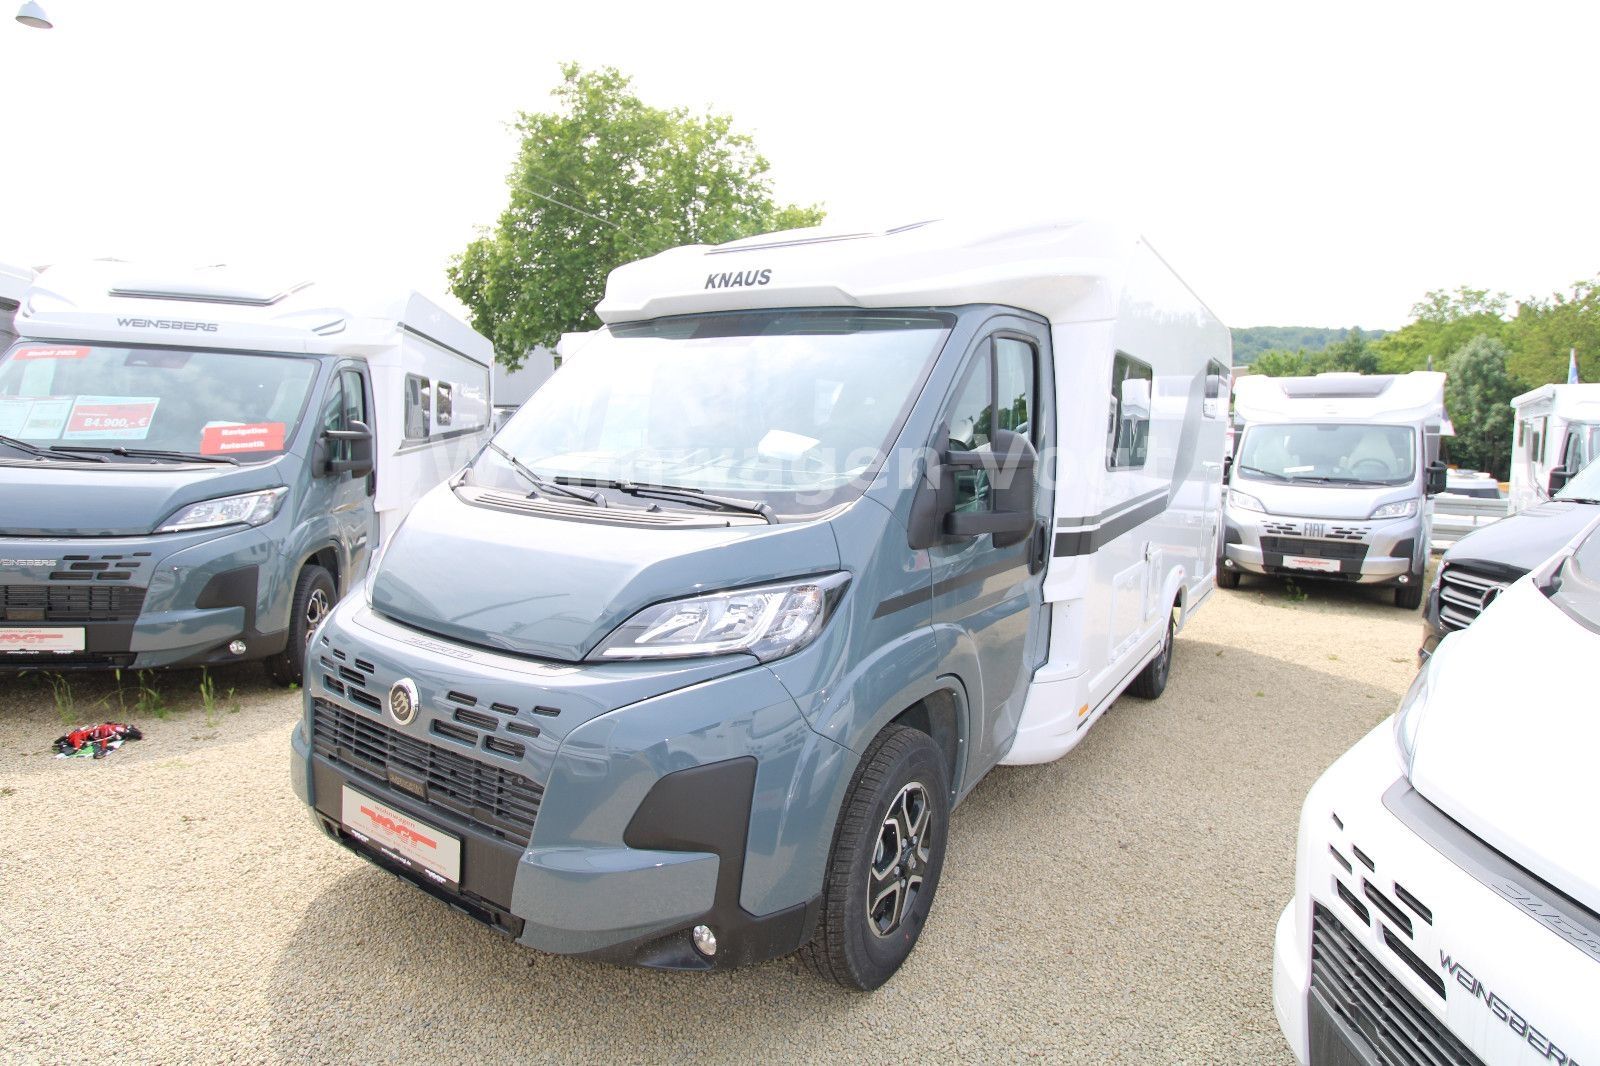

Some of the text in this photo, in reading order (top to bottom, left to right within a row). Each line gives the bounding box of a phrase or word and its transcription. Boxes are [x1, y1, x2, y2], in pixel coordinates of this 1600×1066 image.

[704, 268, 773, 290] KNAUS
[117, 317, 219, 332] WEINSBERG
[138, 416, 148, 427] €
[221, 427, 269, 436] Navigation
[220, 440, 265, 450] Automatik
[1303, 522, 1326, 538] FIAT
[0, 558, 57, 567] EINSBERG
[1440, 948, 1580, 1066] WEINSBER
